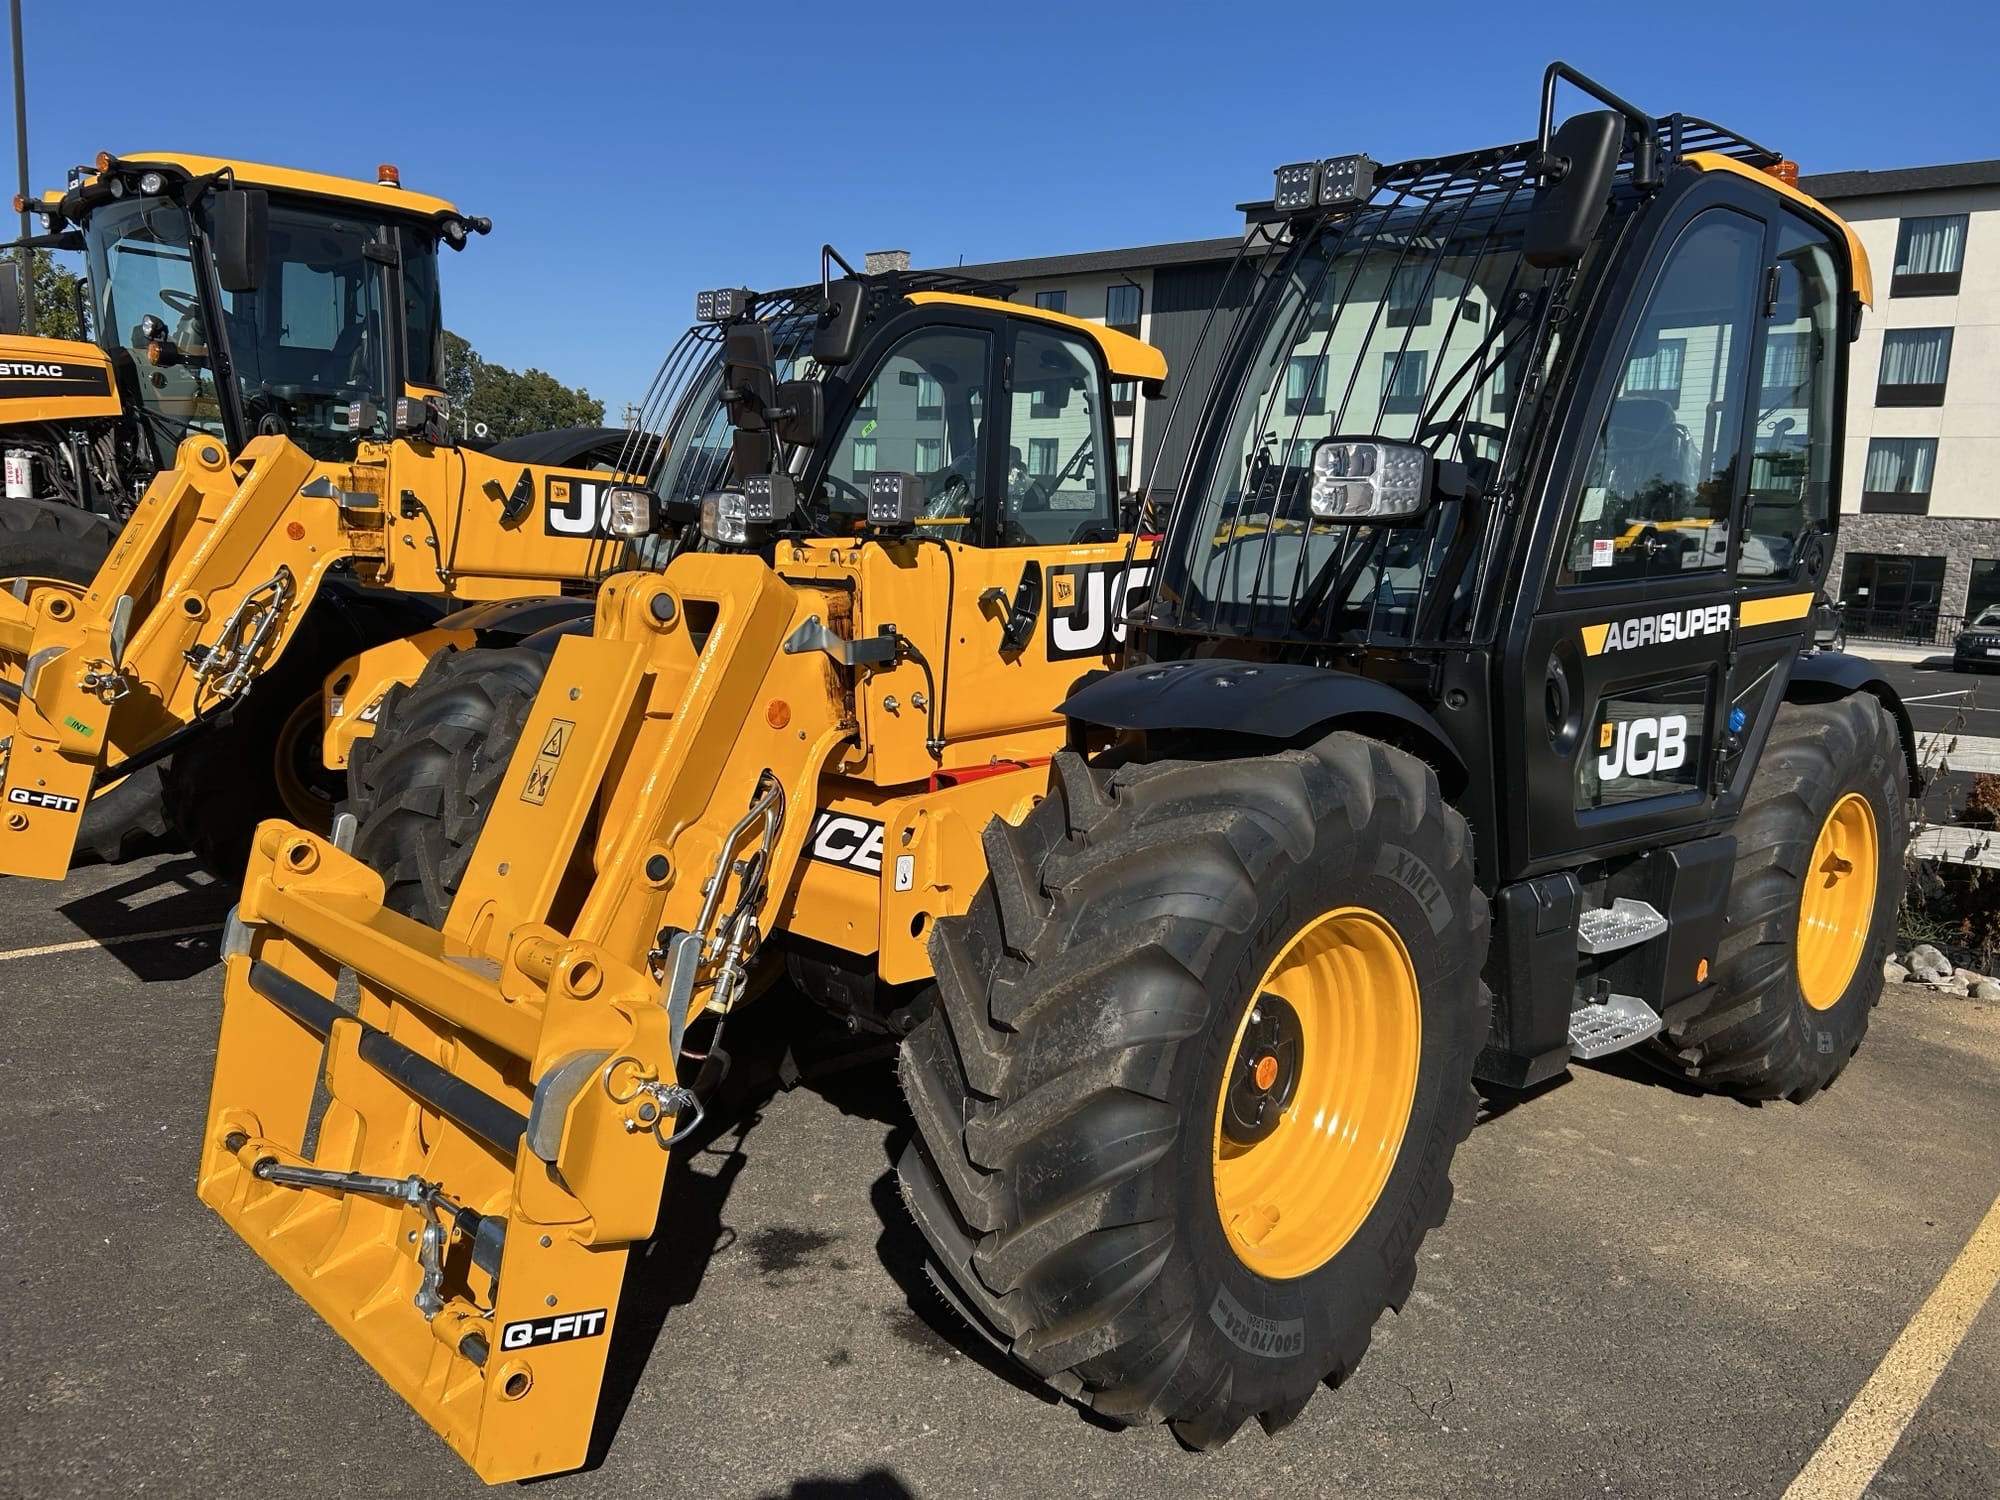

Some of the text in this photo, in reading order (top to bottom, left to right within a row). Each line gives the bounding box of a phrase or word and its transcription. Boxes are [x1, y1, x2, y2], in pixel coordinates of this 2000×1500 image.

[1052, 567, 1156, 651] JC
[1603, 604, 1731, 653] AGRISUPER
[71, 720, 88, 733] INT
[1598, 715, 1687, 780] JCB
[10, 789, 79, 811] Q-FIT
[1389, 851, 1441, 914] XMCL
[504, 1311, 605, 1348] Q-FIT
[1250, 1330, 1302, 1353] 500/70
